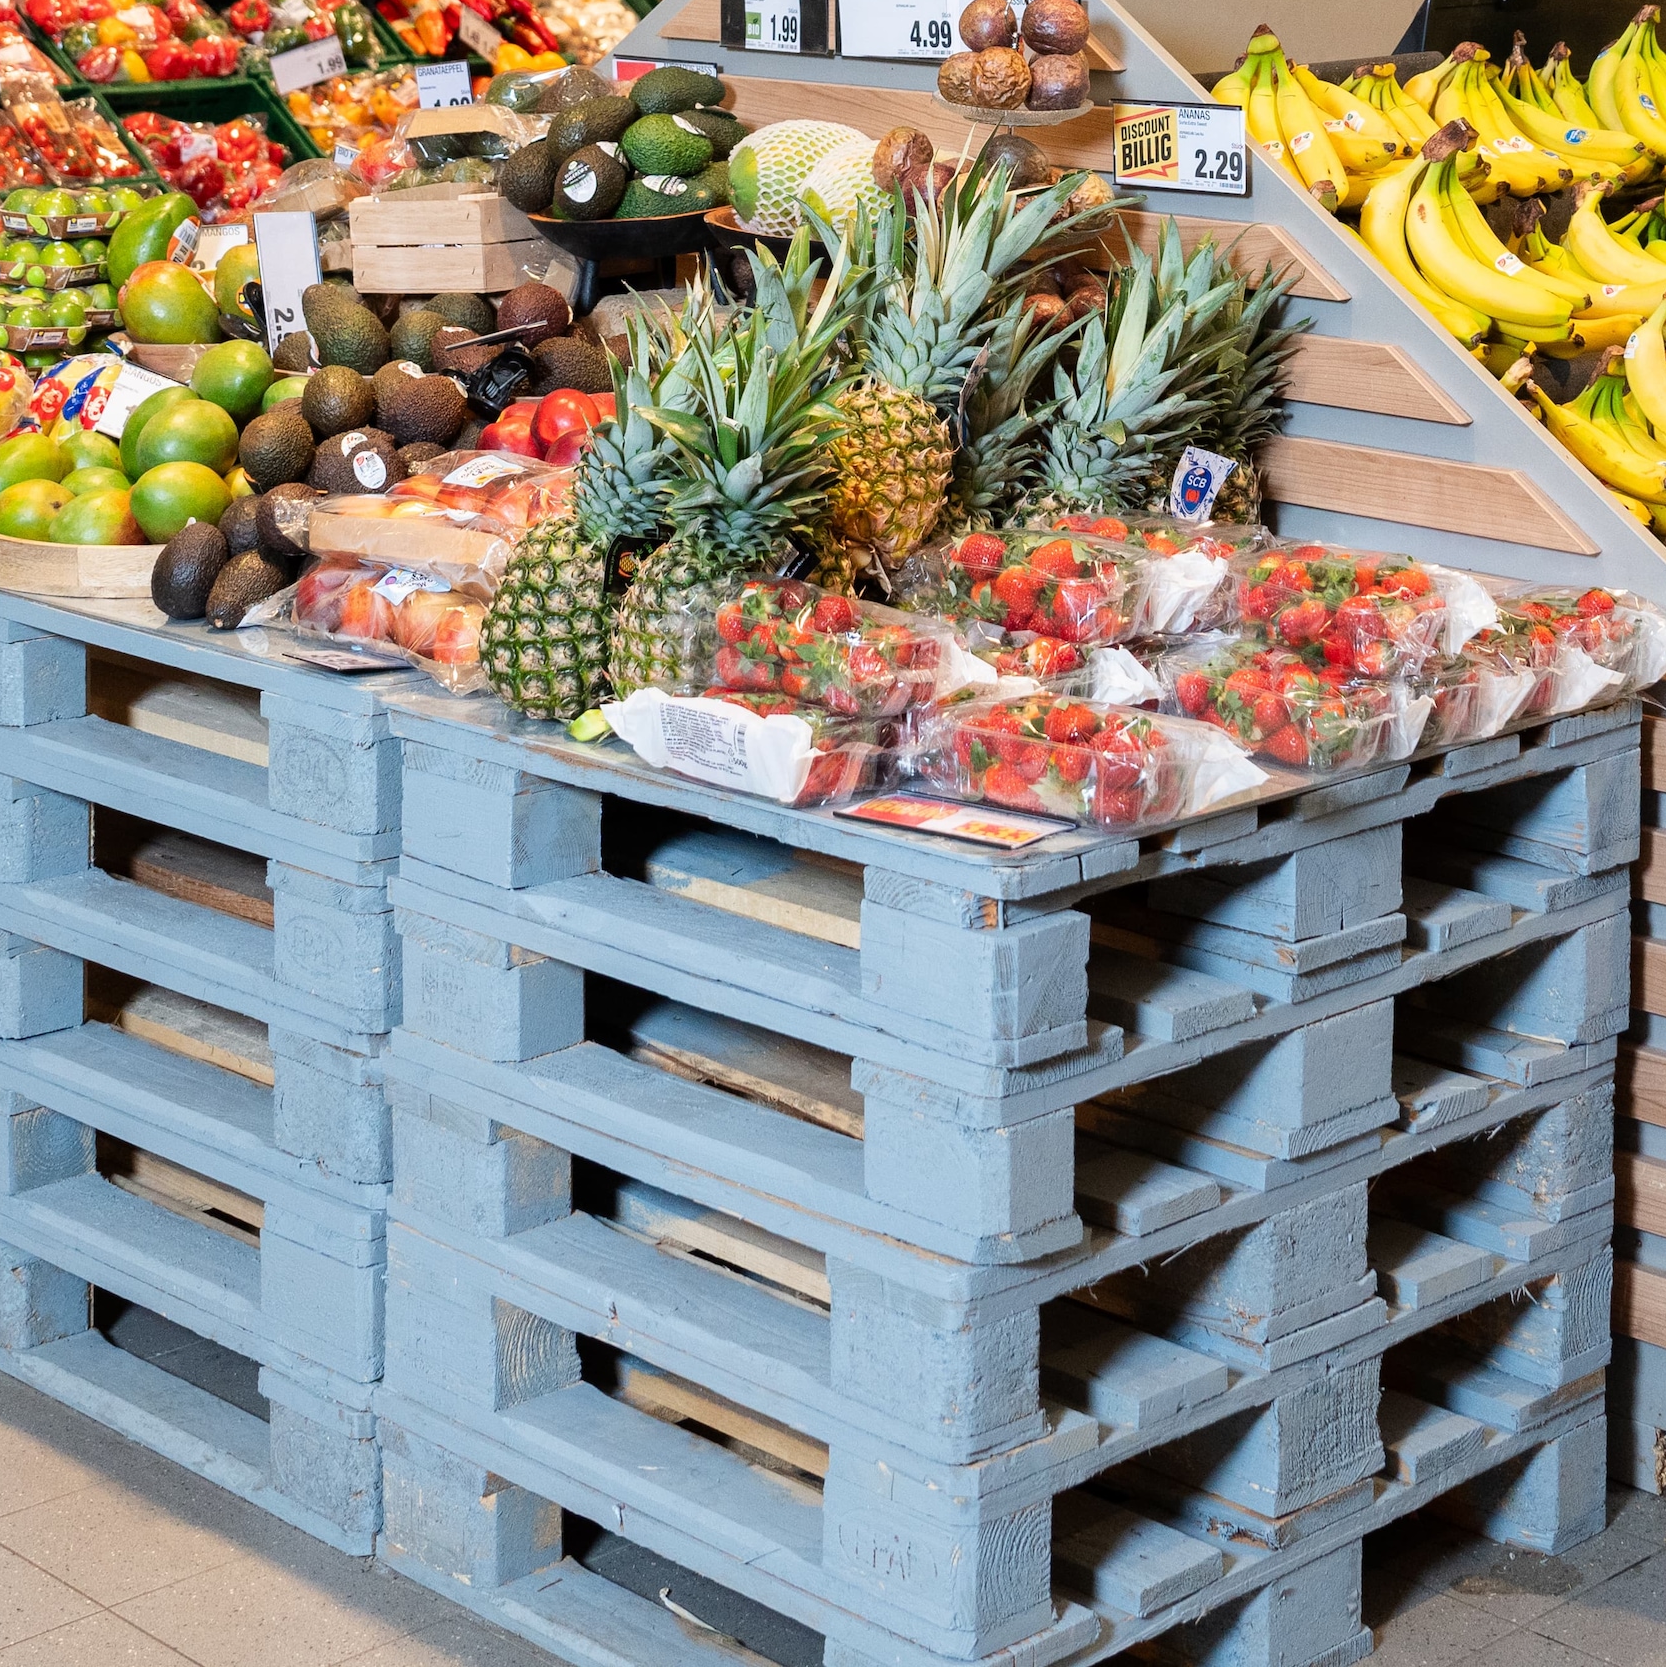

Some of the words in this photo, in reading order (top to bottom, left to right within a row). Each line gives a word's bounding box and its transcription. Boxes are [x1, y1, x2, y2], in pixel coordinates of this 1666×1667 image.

[747, 22, 760, 37] BIO
[770, 14, 798, 43] 1.99
[910, 20, 952, 49] 4.99
[317, 54, 344, 75] 1.99
[417, 64, 464, 77] GRANATAEPFEL
[1178, 109, 1211, 120] ANANAS
[1121, 115, 1171, 142] DISCOUNT
[1122, 133, 1172, 171] BILLIG
[1194, 148, 1243, 182] 2.29
[1187, 475, 1208, 488] SCB
